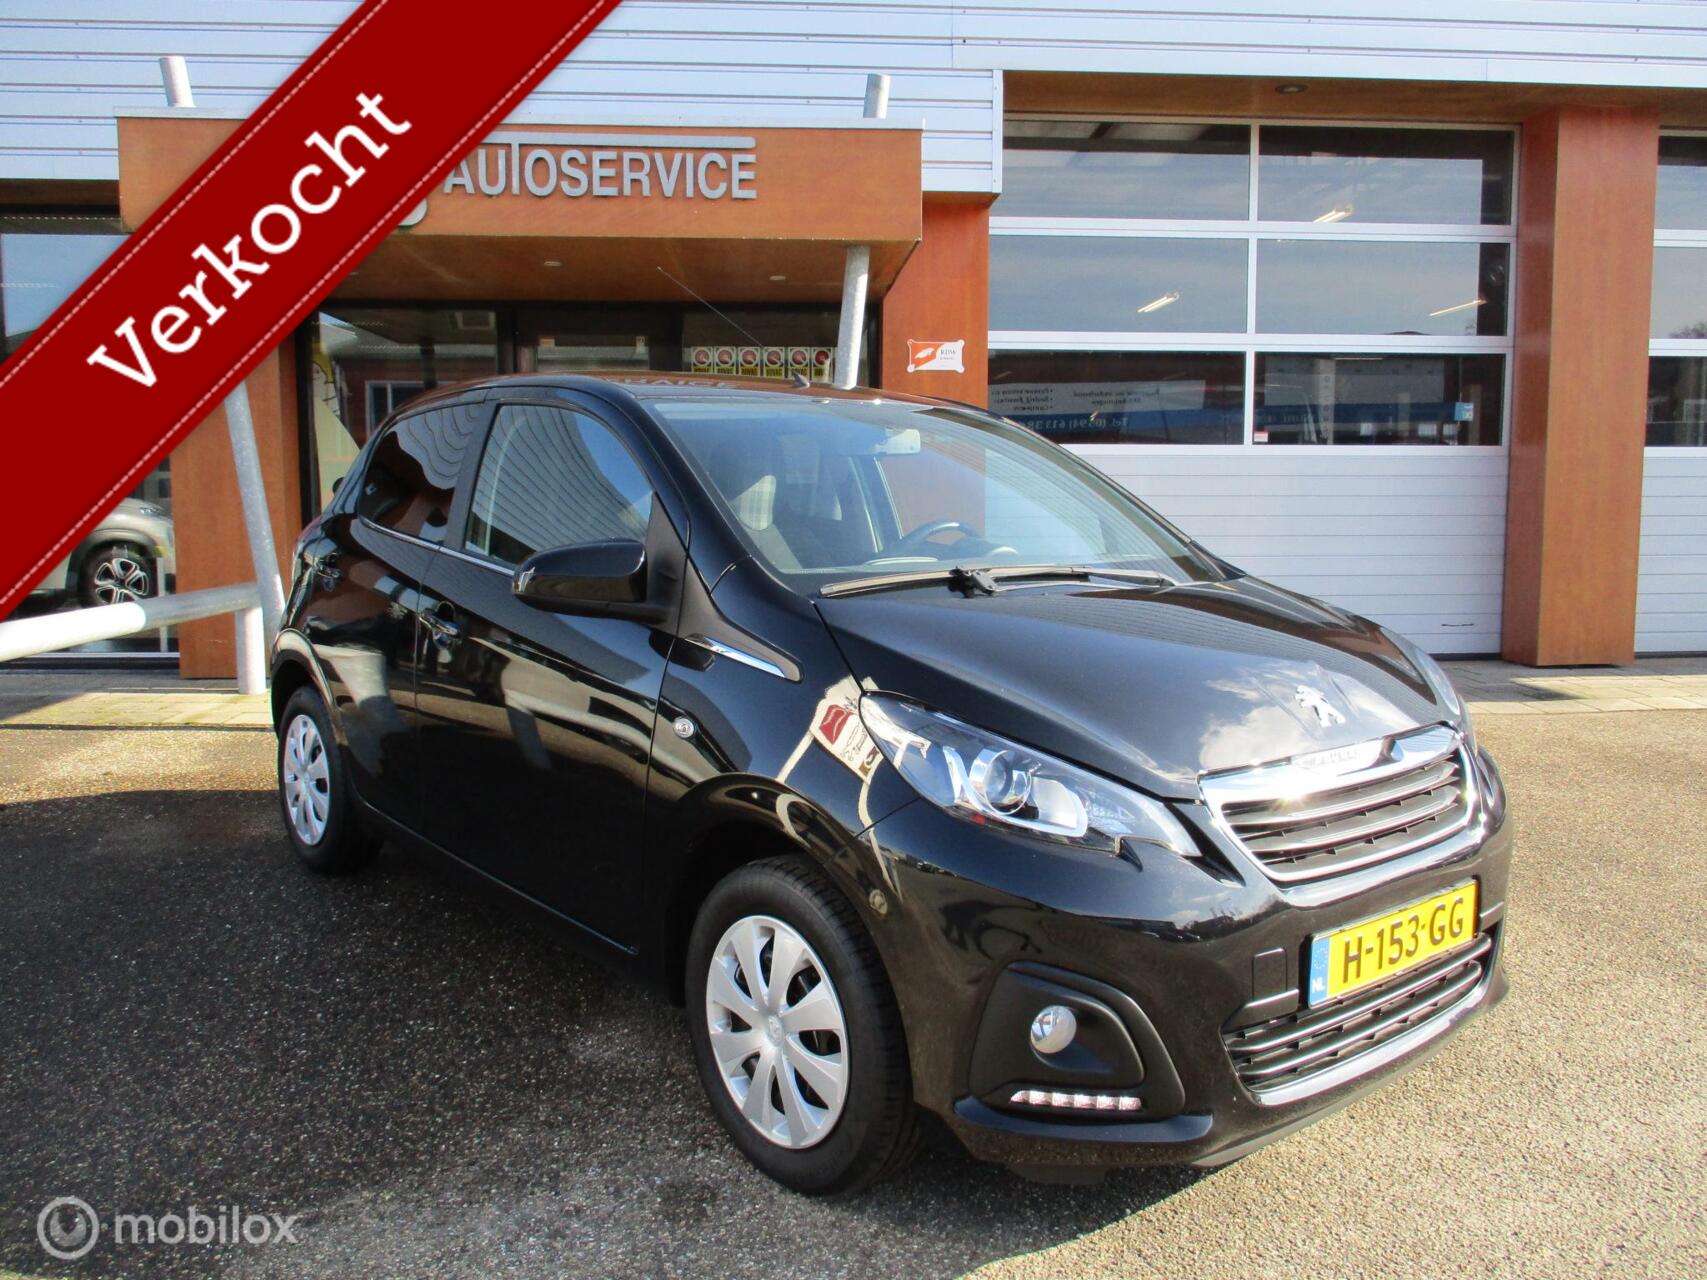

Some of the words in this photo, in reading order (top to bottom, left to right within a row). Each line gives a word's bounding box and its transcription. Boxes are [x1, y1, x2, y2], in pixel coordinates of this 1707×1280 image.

[443, 132, 758, 200] AUTOSERVICE
[1343, 897, 1463, 984] H-153-GG
[1312, 977, 1325, 993] NL
